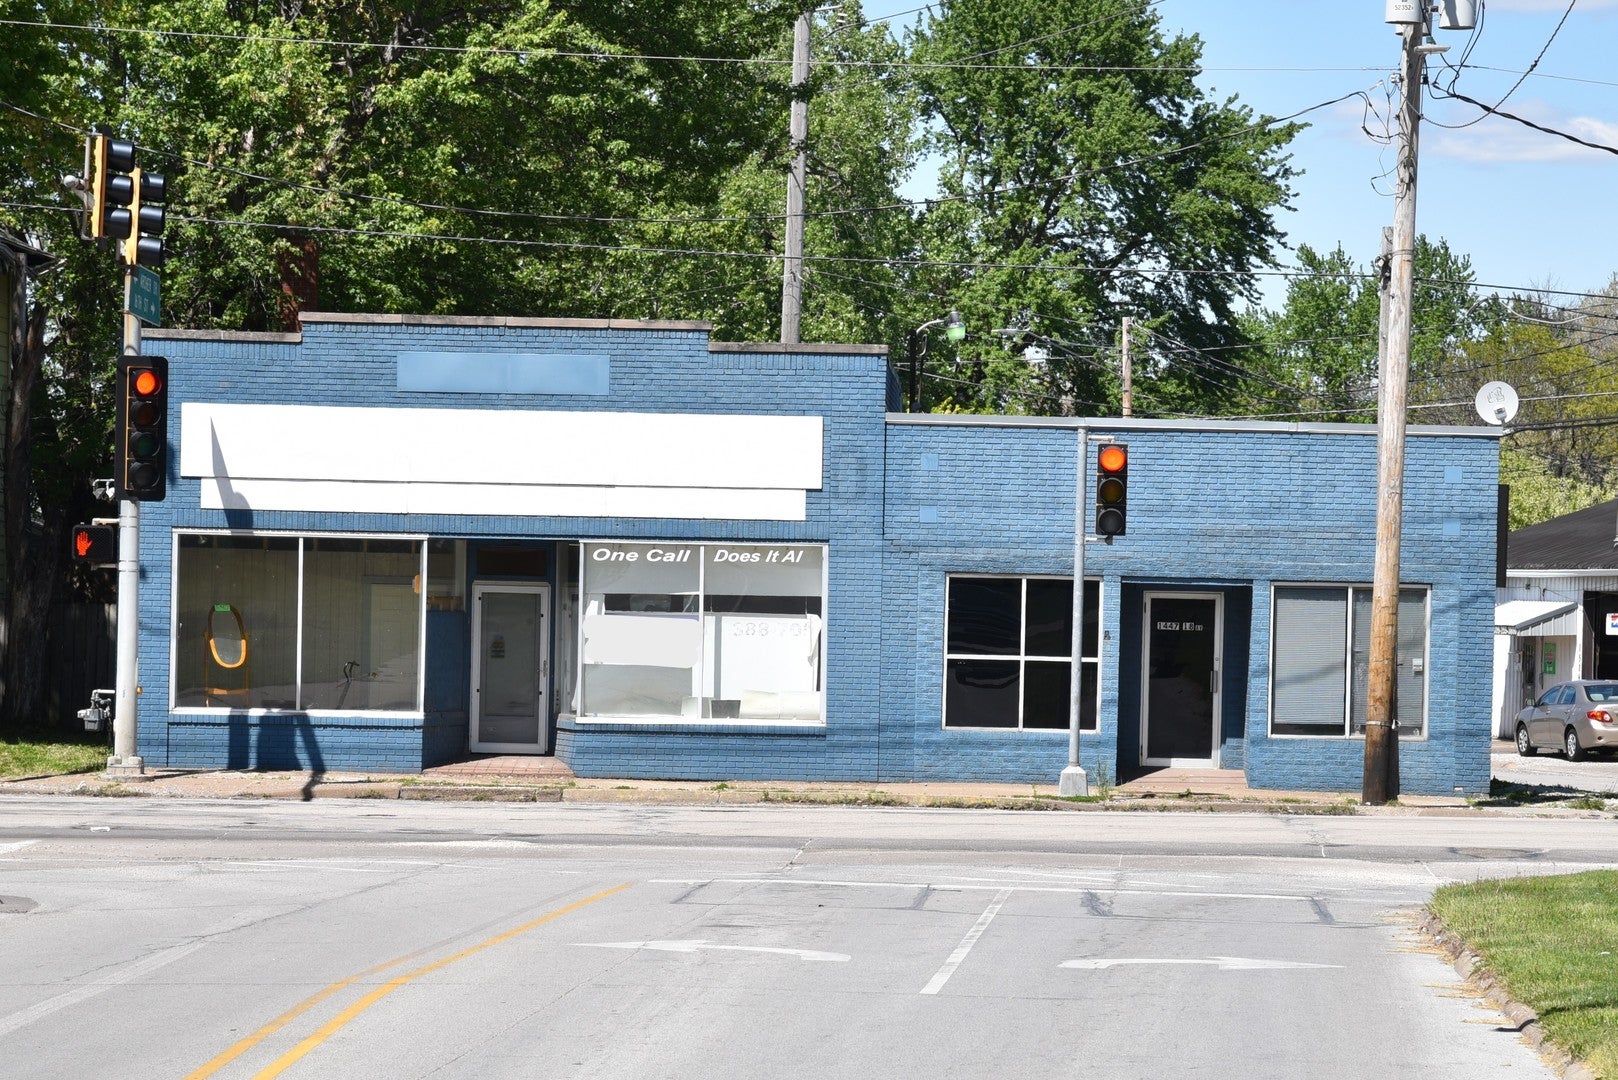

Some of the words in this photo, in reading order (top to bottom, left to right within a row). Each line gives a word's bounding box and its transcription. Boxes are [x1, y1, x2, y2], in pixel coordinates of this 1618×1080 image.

[592, 548, 639, 562] One
[646, 549, 692, 563] Call
[713, 549, 761, 563] Does
[765, 550, 780, 563] It
